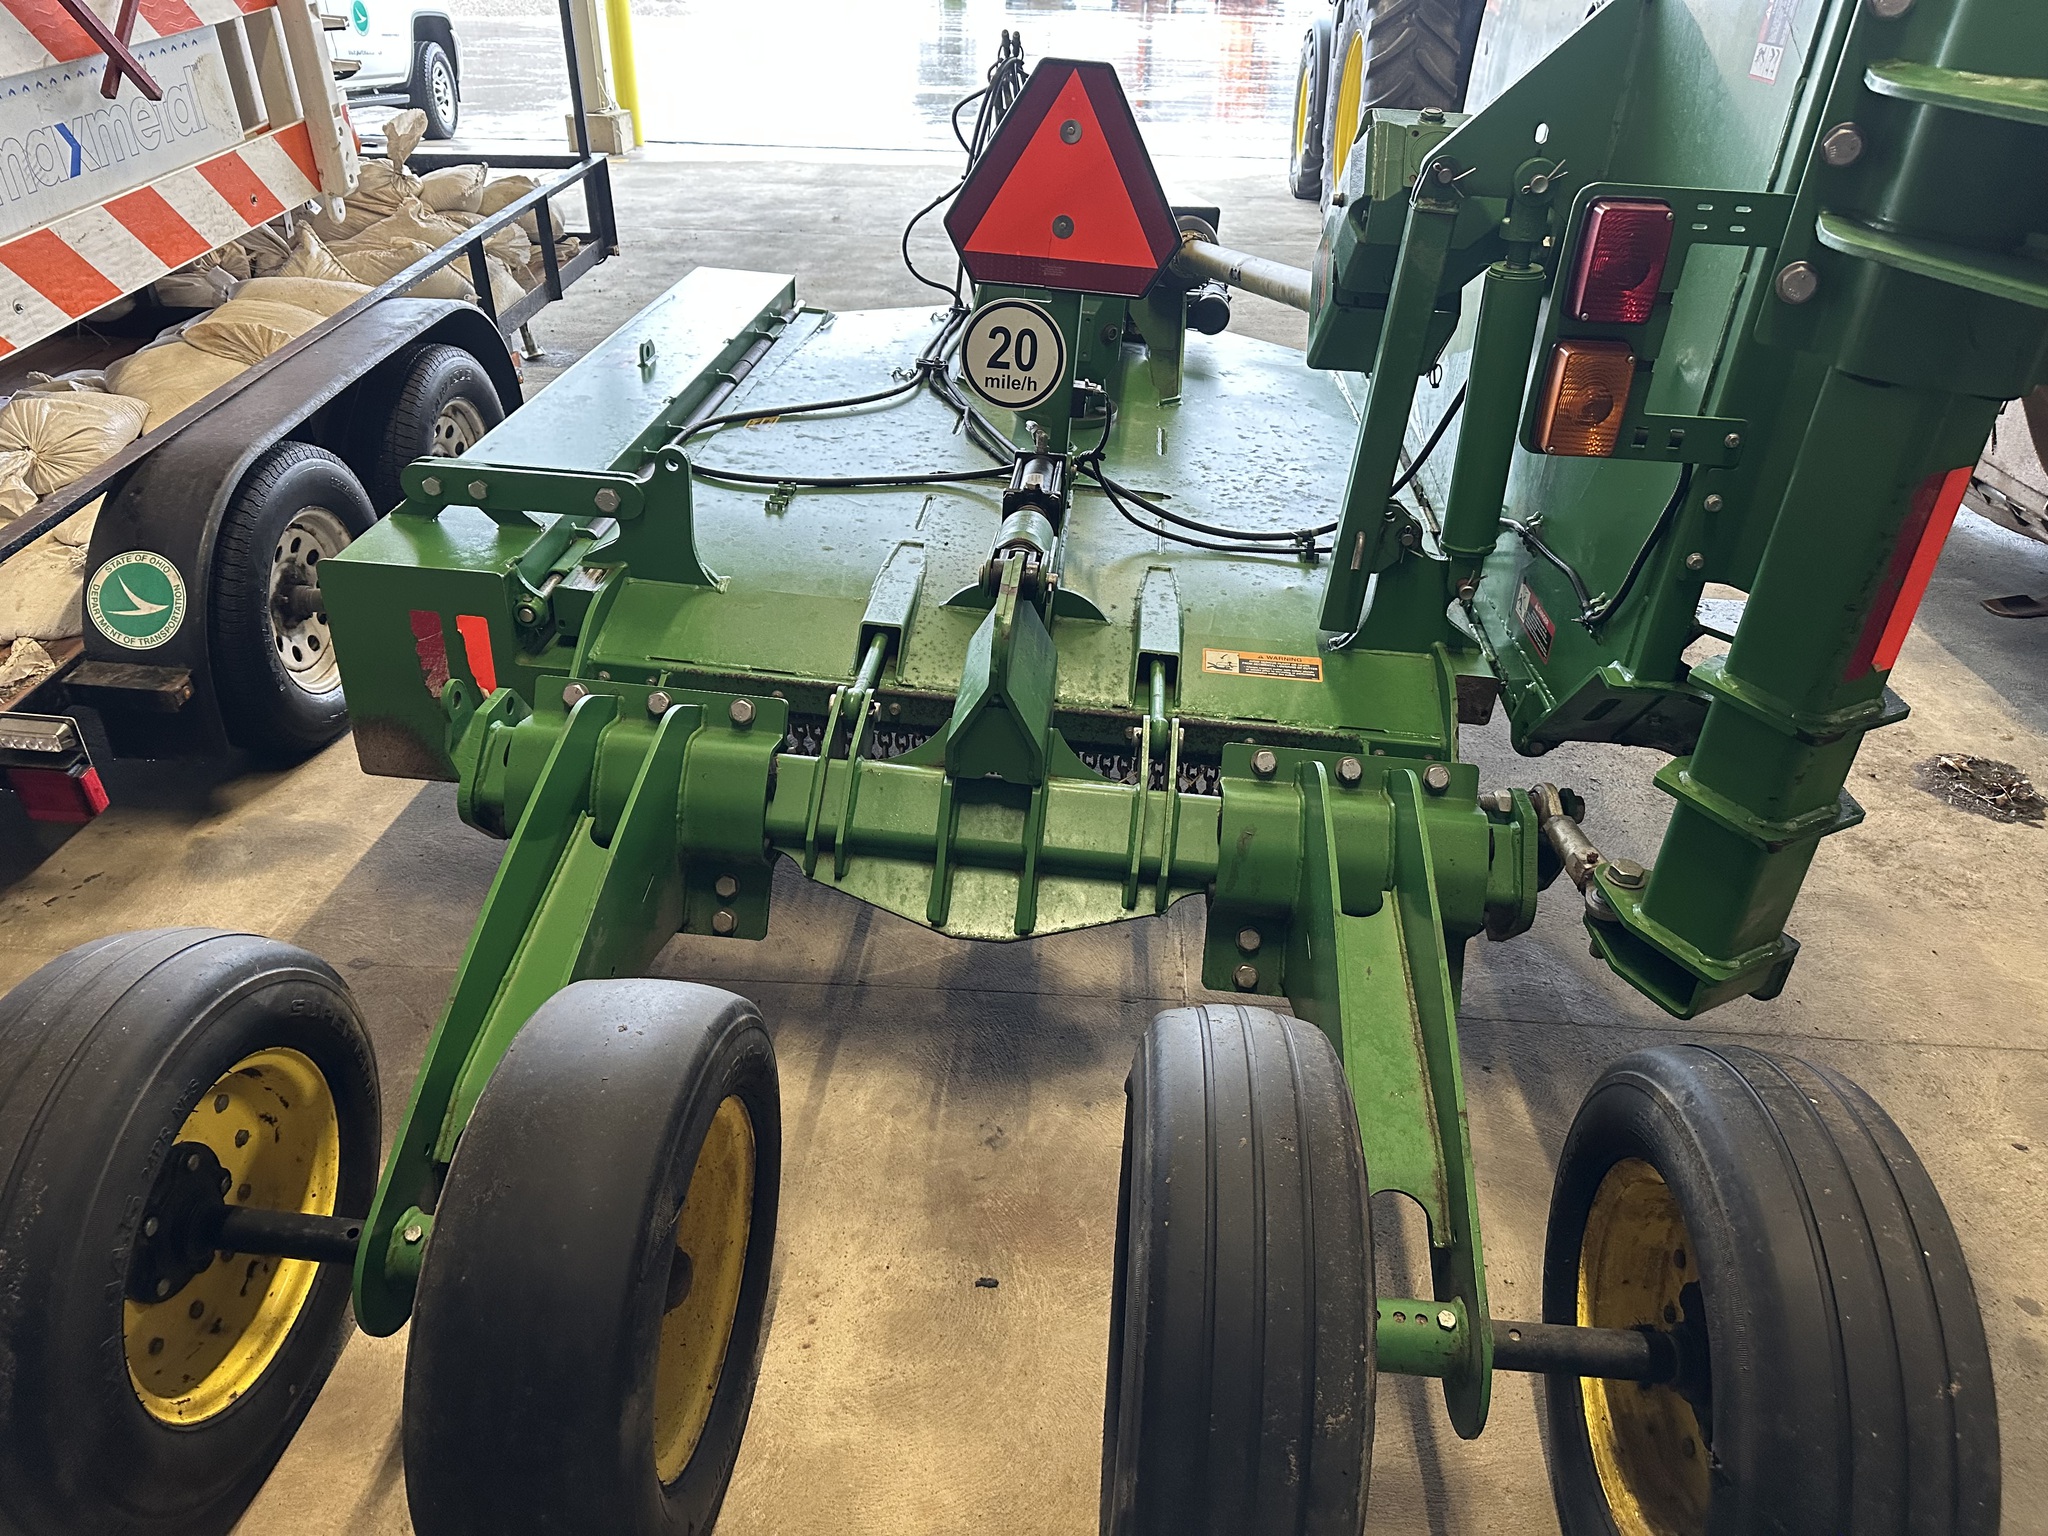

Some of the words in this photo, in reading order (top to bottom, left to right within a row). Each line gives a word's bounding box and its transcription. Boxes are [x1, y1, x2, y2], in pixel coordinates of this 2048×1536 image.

[986, 326, 1038, 372] 20
[985, 374, 1037, 391] mile/h
[105, 554, 132, 573] STATE
[134, 554, 147, 562] OF
[149, 556, 171, 574] OHIO
[90, 583, 122, 640] DEPARTMENT
[123, 637, 136, 645] OF
[138, 583, 182, 646] TRANSPORTATION
